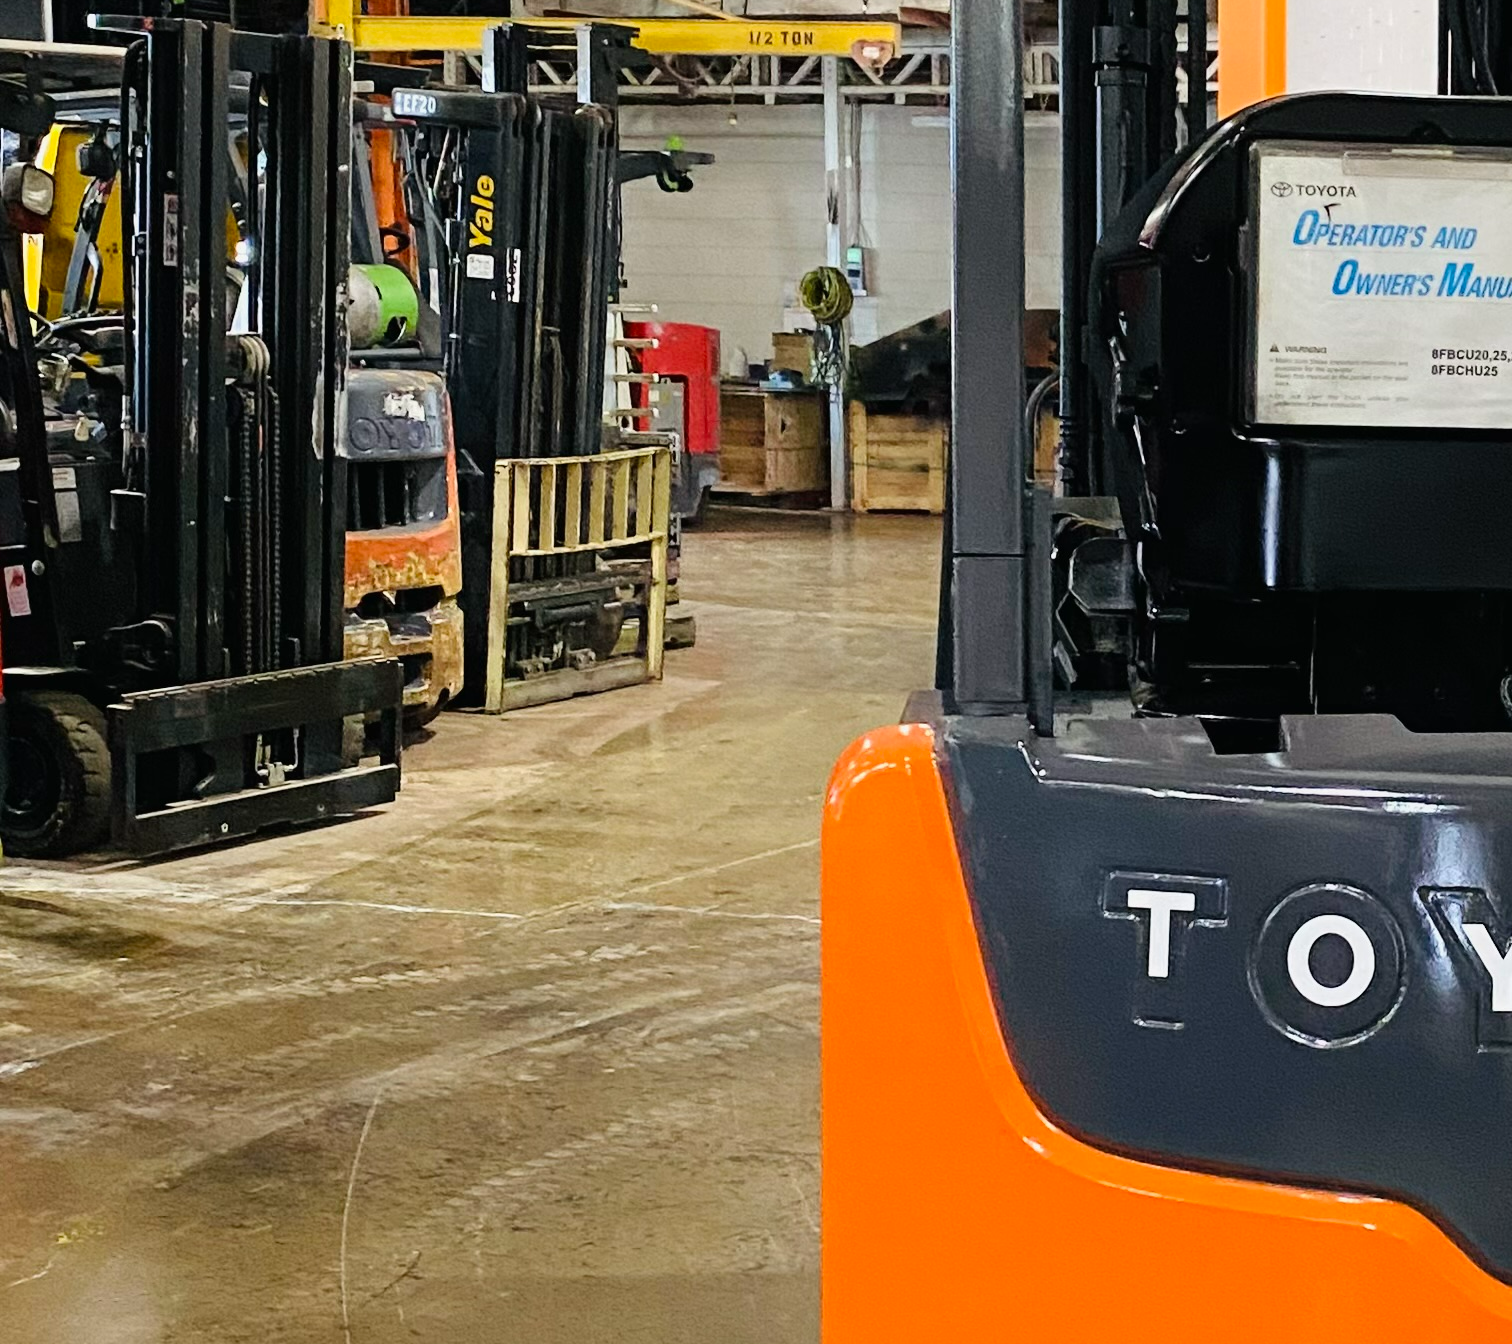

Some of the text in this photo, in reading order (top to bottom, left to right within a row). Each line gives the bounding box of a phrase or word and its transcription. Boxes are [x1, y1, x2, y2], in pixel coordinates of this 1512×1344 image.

[749, 30, 813, 45] 1/2 TON
[1296, 184, 1357, 198] TOYOTA
[468, 174, 495, 248] Yale
[1430, 226, 1478, 250] AND
[1431, 364, 1498, 377] 8FBCHU25
